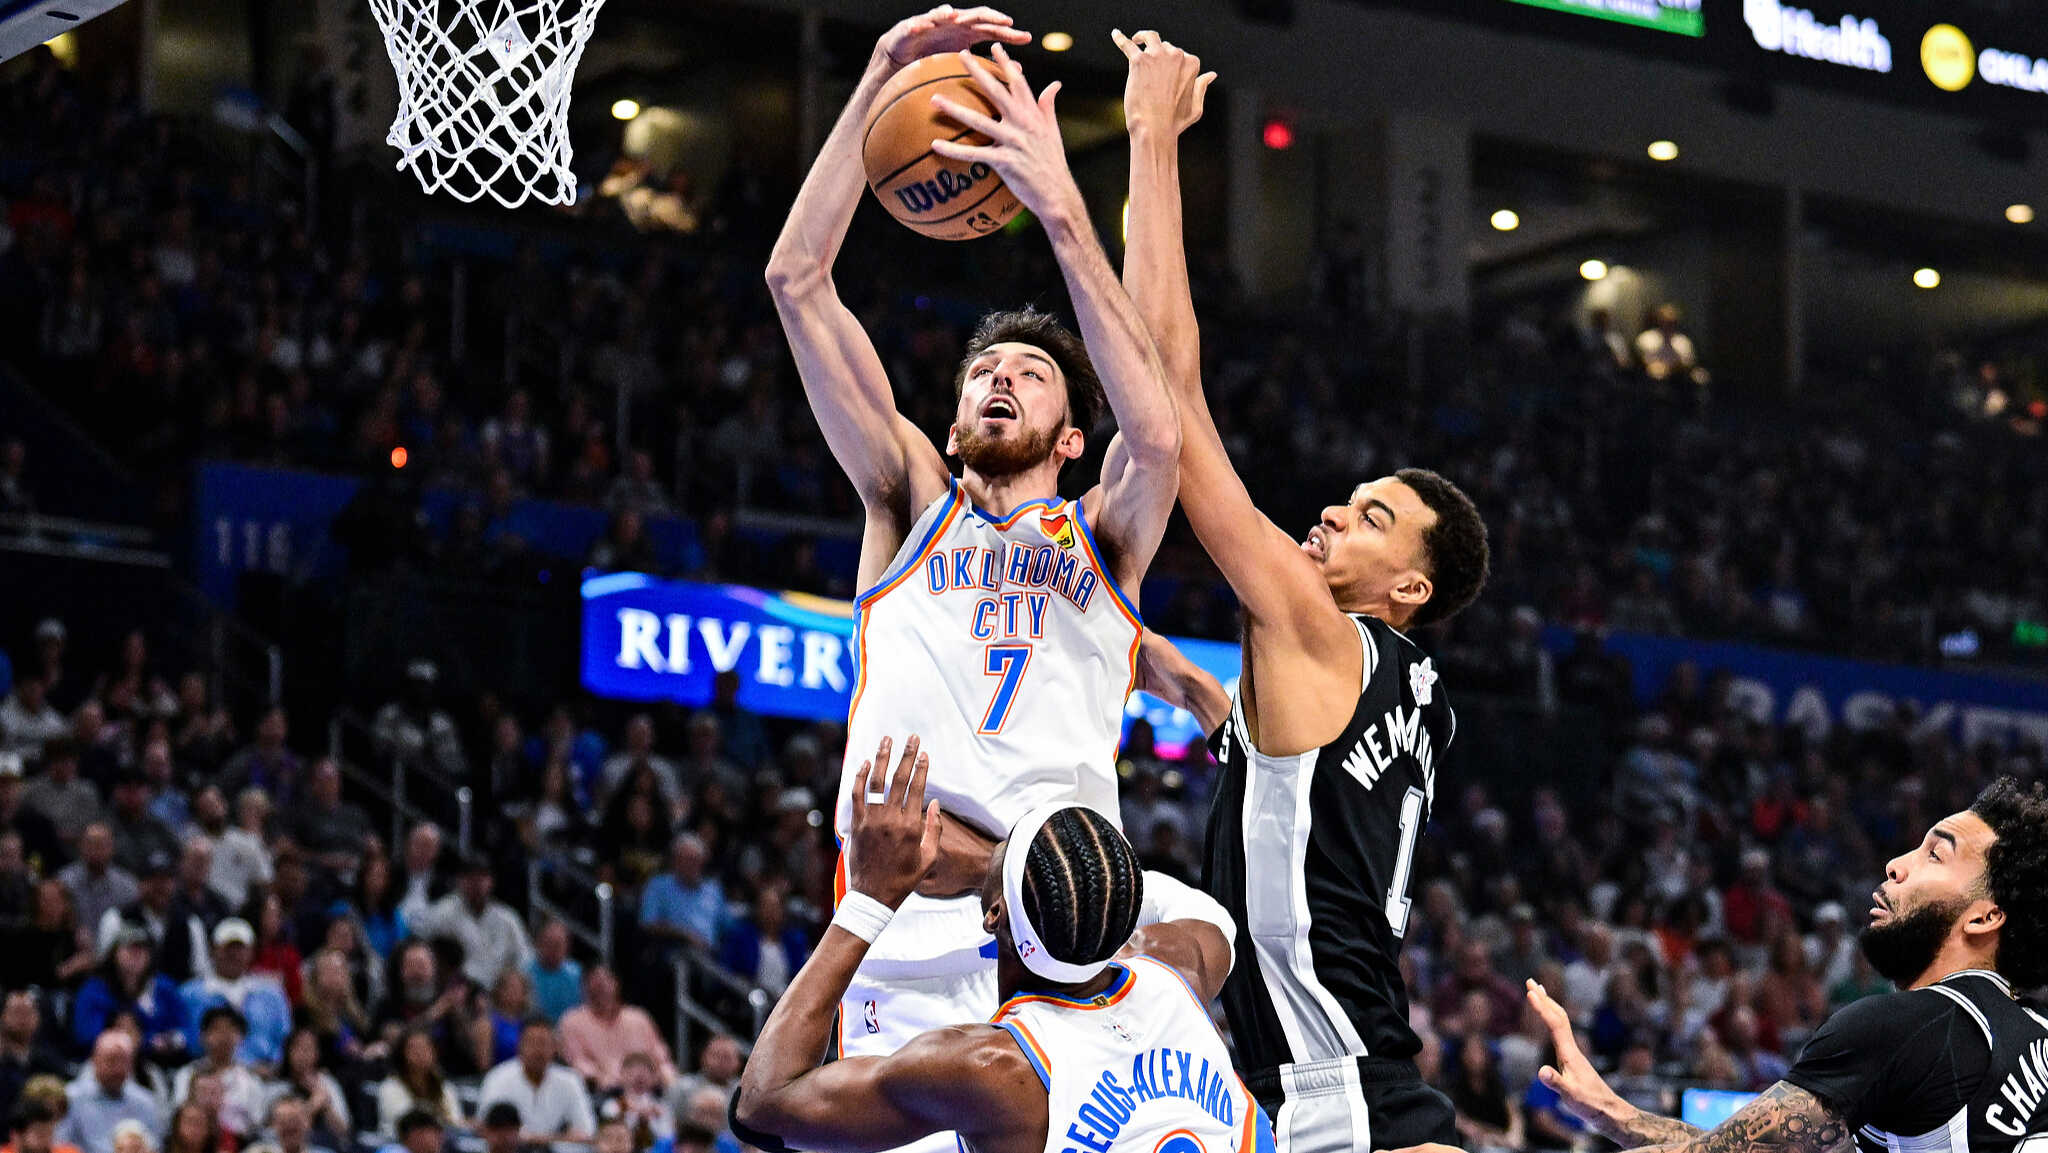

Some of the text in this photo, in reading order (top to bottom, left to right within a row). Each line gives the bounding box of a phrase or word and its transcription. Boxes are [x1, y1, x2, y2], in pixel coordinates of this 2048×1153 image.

[894, 161, 992, 214] Wilso
[926, 541, 1099, 614] OKLHOMA
[970, 591, 1050, 641] CTY
[615, 606, 854, 693] RIVER
[977, 644, 1033, 734] 7
[1385, 785, 1424, 938] 1
[1060, 1047, 1234, 1153] EOUS-ALEXAND
